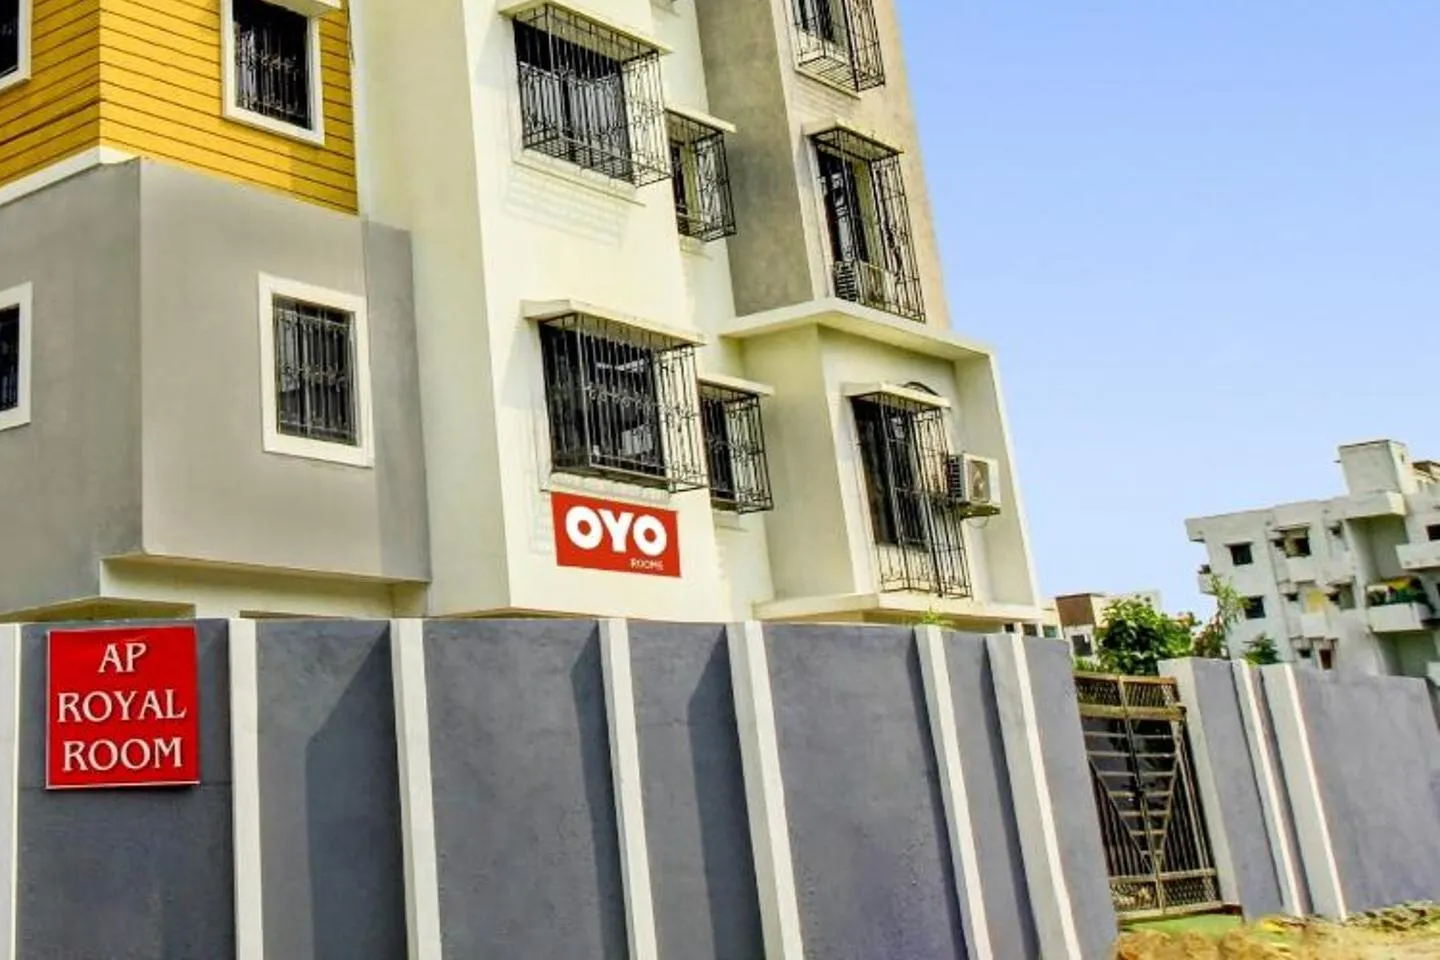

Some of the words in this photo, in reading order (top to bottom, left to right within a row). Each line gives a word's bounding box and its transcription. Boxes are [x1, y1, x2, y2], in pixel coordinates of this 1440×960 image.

[565, 505, 668, 557] OYO
[629, 557, 665, 571] ROOMS
[97, 642, 148, 673] AP
[57, 689, 188, 723] ROYAL
[62, 736, 184, 772] ROOM
